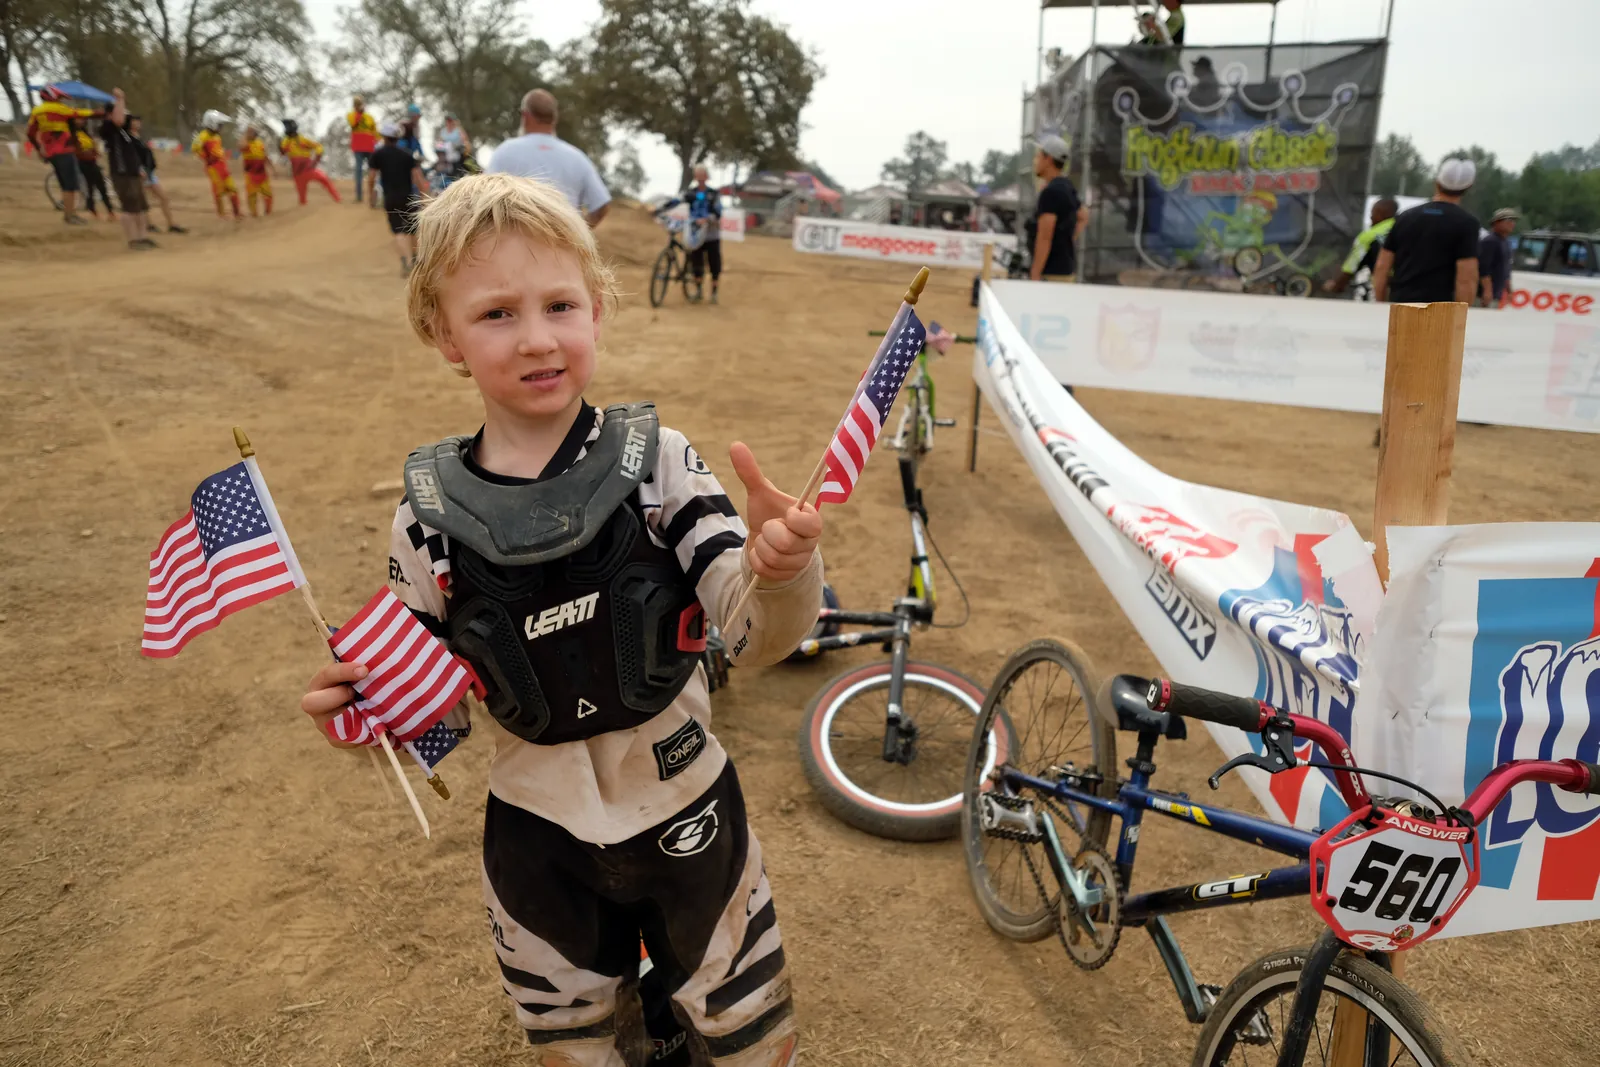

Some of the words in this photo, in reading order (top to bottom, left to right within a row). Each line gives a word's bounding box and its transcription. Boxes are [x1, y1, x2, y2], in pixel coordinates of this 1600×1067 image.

[1249, 120, 1337, 170] Classic
[842, 233, 937, 257] mongoose
[524, 591, 600, 641] LEATT
[1147, 565, 1217, 661] BMX
[1385, 816, 1468, 840] ANSWER
[1197, 873, 1263, 899] GT
[1338, 840, 1462, 923] 560
[1270, 957, 1292, 969] TIOGA
